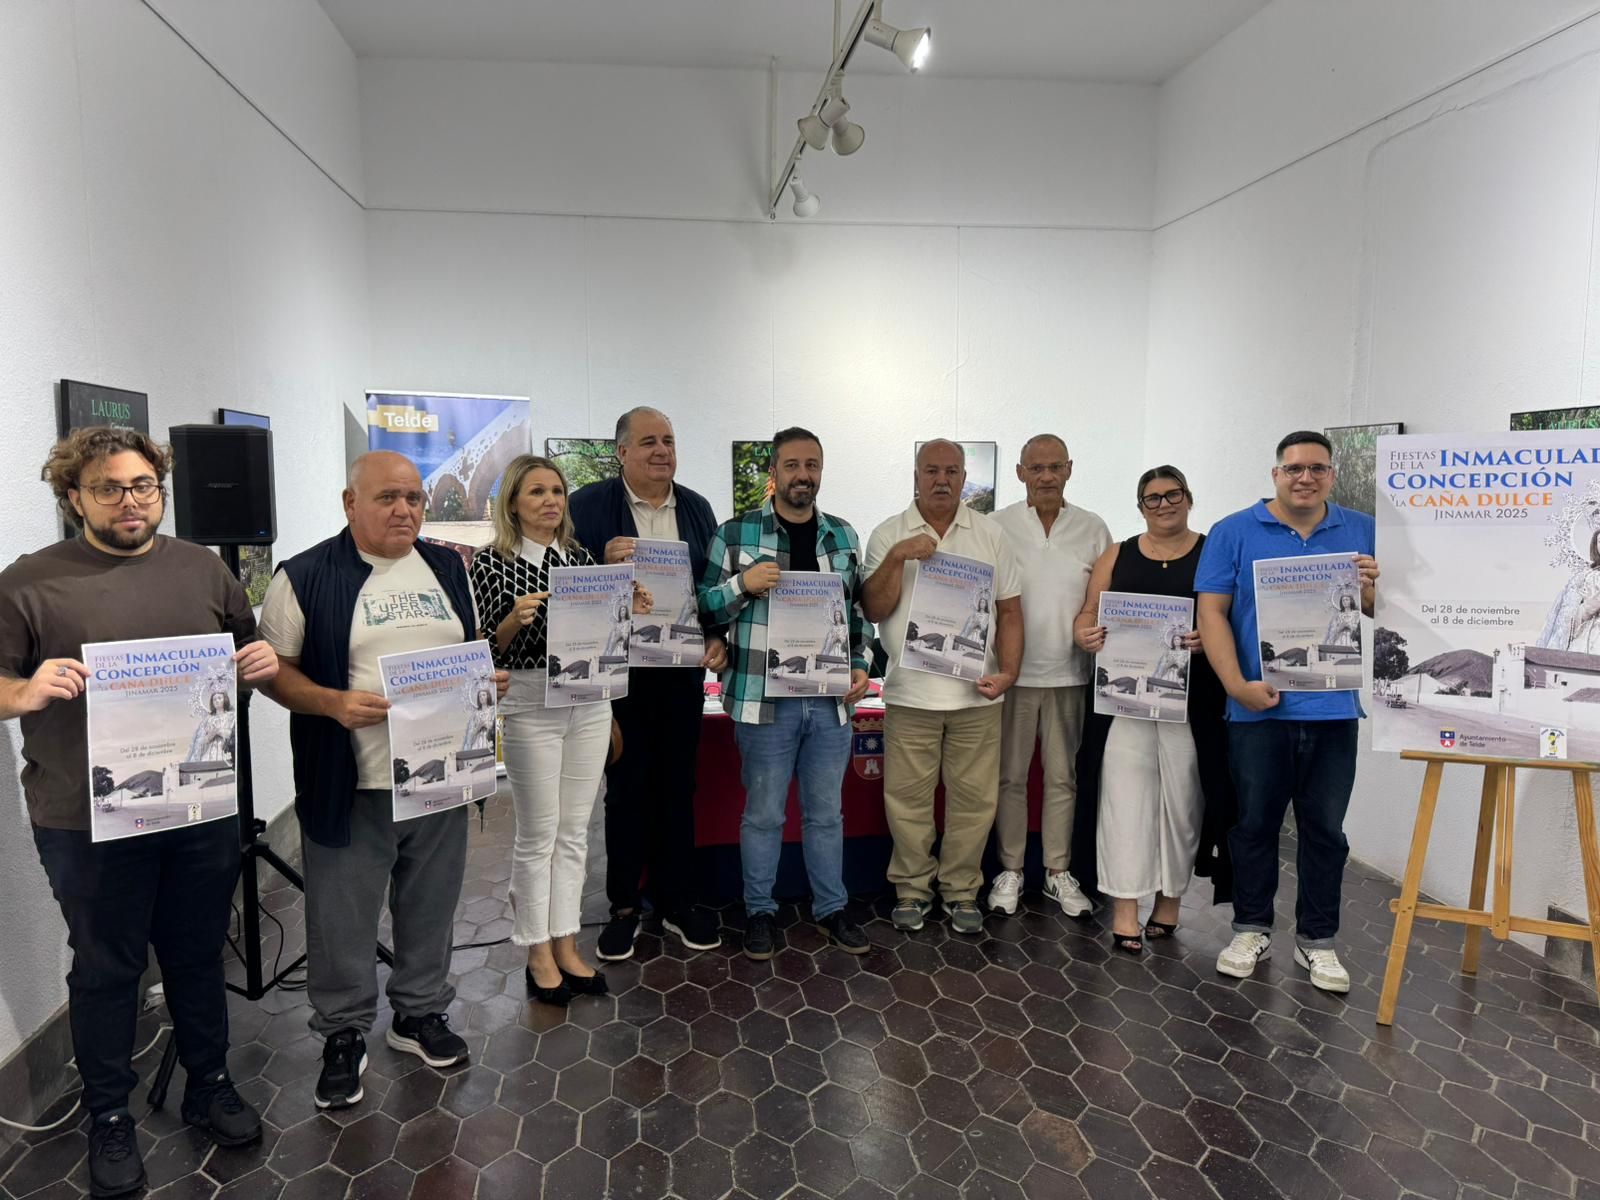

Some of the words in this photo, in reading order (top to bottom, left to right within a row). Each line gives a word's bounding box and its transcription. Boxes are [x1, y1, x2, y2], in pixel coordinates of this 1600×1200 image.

[91, 399, 130, 419] LAURUS
[383, 412, 433, 428] Telde
[1390, 451, 1436, 461] FIESTAS
[1390, 461, 1406, 470] DE
[1411, 461, 1424, 470] LA
[1387, 467, 1573, 490] CONCEPCIÓN
[1395, 499, 1406, 507] LA
[1409, 491, 1469, 507] CAÑA
[1477, 492, 1553, 507] DULCE
[1434, 509, 1492, 521] JINAMAR
[1496, 508, 1528, 519] 2025
[1280, 562, 1353, 574] INMACULADA
[572, 573, 630, 584] INMACULADA
[1260, 572, 1332, 585] CONCEPCIÓN
[554, 582, 616, 594] CONCEPCIÓN
[389, 593, 418, 604] THE
[1122, 600, 1187, 613] INMACULADA
[1421, 604, 1437, 614] Del
[1440, 605, 1453, 614] 28
[1456, 604, 1468, 614] de
[1471, 605, 1521, 615] noviembre
[1430, 616, 1440, 624] al
[1443, 616, 1449, 625] 8
[1452, 616, 1464, 625] de
[1466, 616, 1514, 626] diciembre
[126, 647, 227, 665] INMACULADA
[411, 651, 486, 672] INMACULADA
[95, 660, 200, 681] CONCEPCIÓN
[390, 665, 468, 687] CONCEPCIÓN
